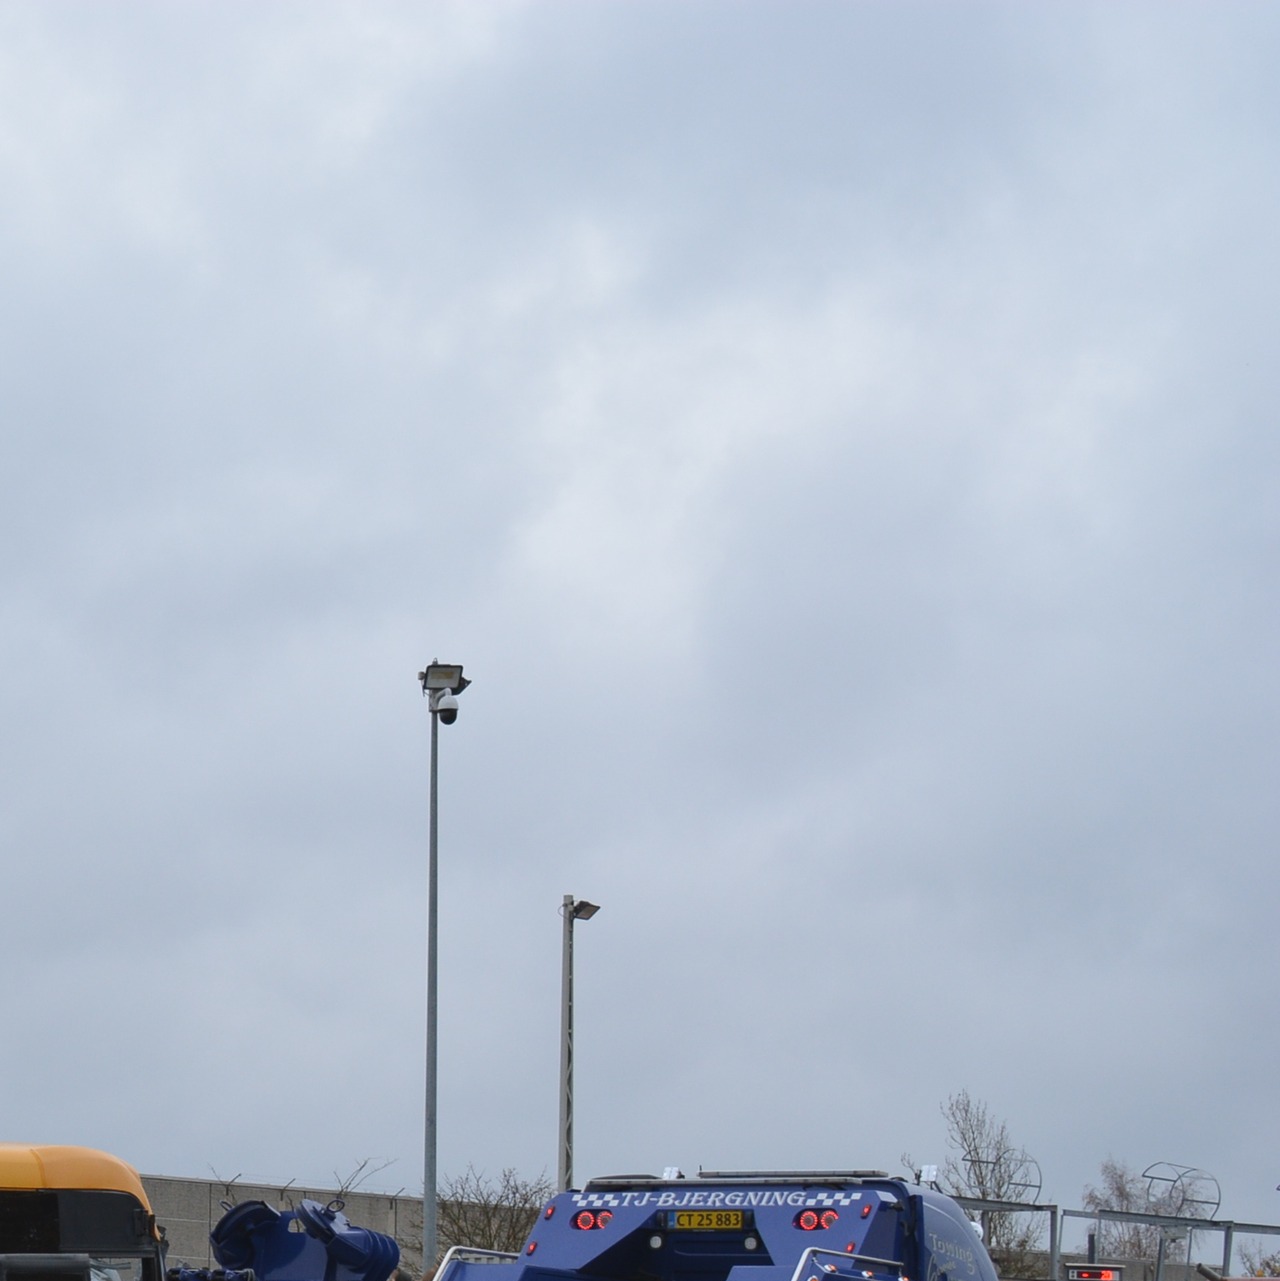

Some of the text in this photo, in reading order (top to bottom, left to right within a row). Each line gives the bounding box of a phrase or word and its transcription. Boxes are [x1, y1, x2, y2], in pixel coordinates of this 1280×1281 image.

[621, 1192, 807, 1207] TJ-BJERGNING
[676, 1211, 741, 1228] CT 25 883
